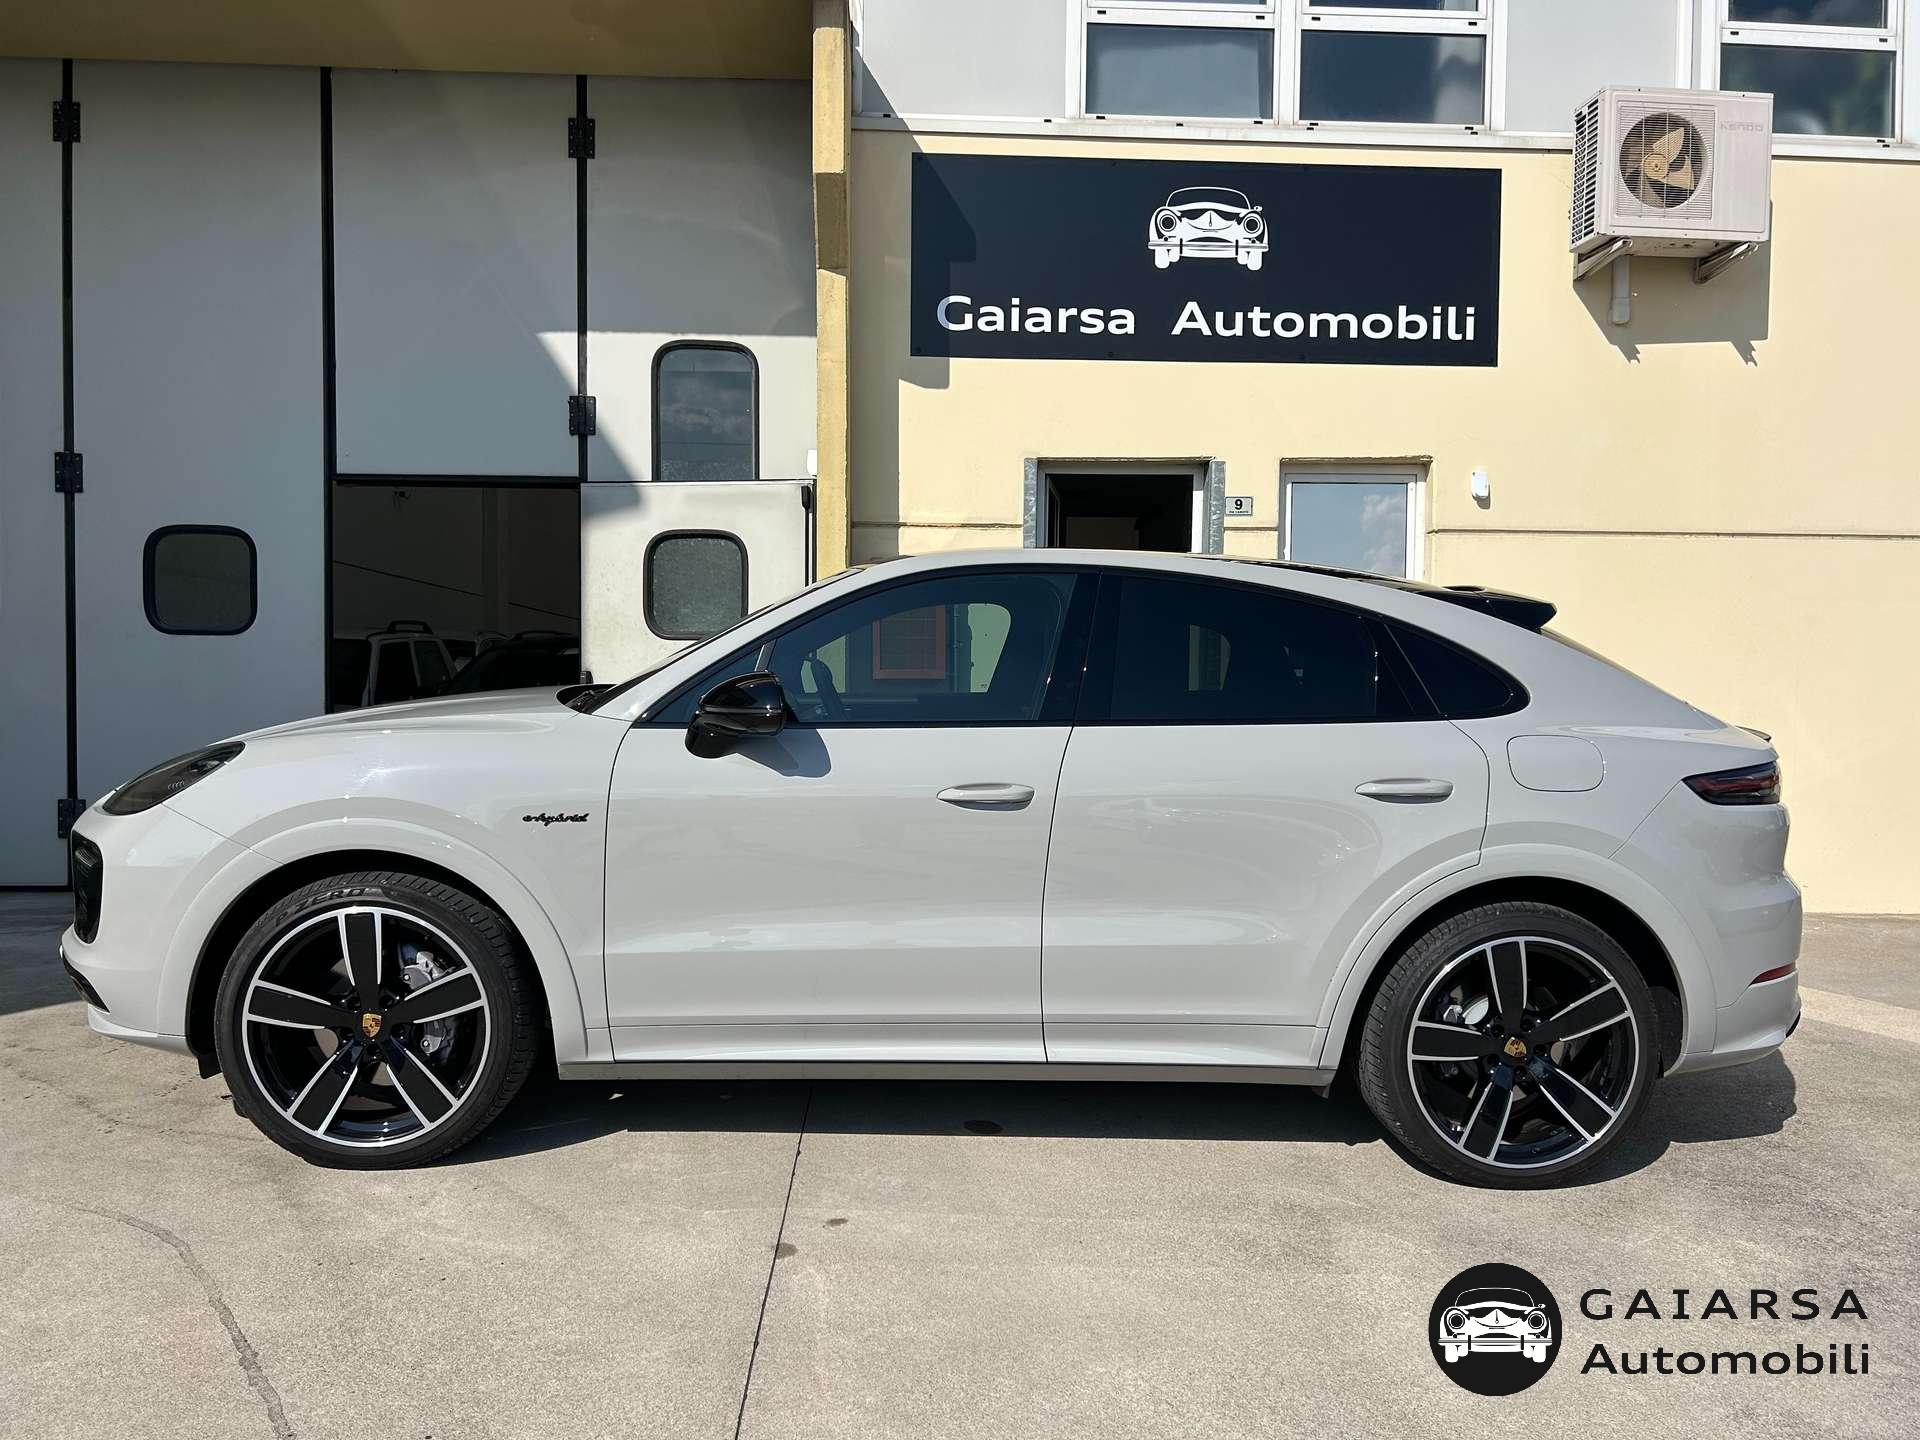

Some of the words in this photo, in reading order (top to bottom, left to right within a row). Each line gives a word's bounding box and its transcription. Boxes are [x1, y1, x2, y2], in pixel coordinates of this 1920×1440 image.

[937, 295, 1134, 334] Gaiarsa
[1171, 302, 1474, 340] Automobili
[1235, 499, 1242, 510] 9
